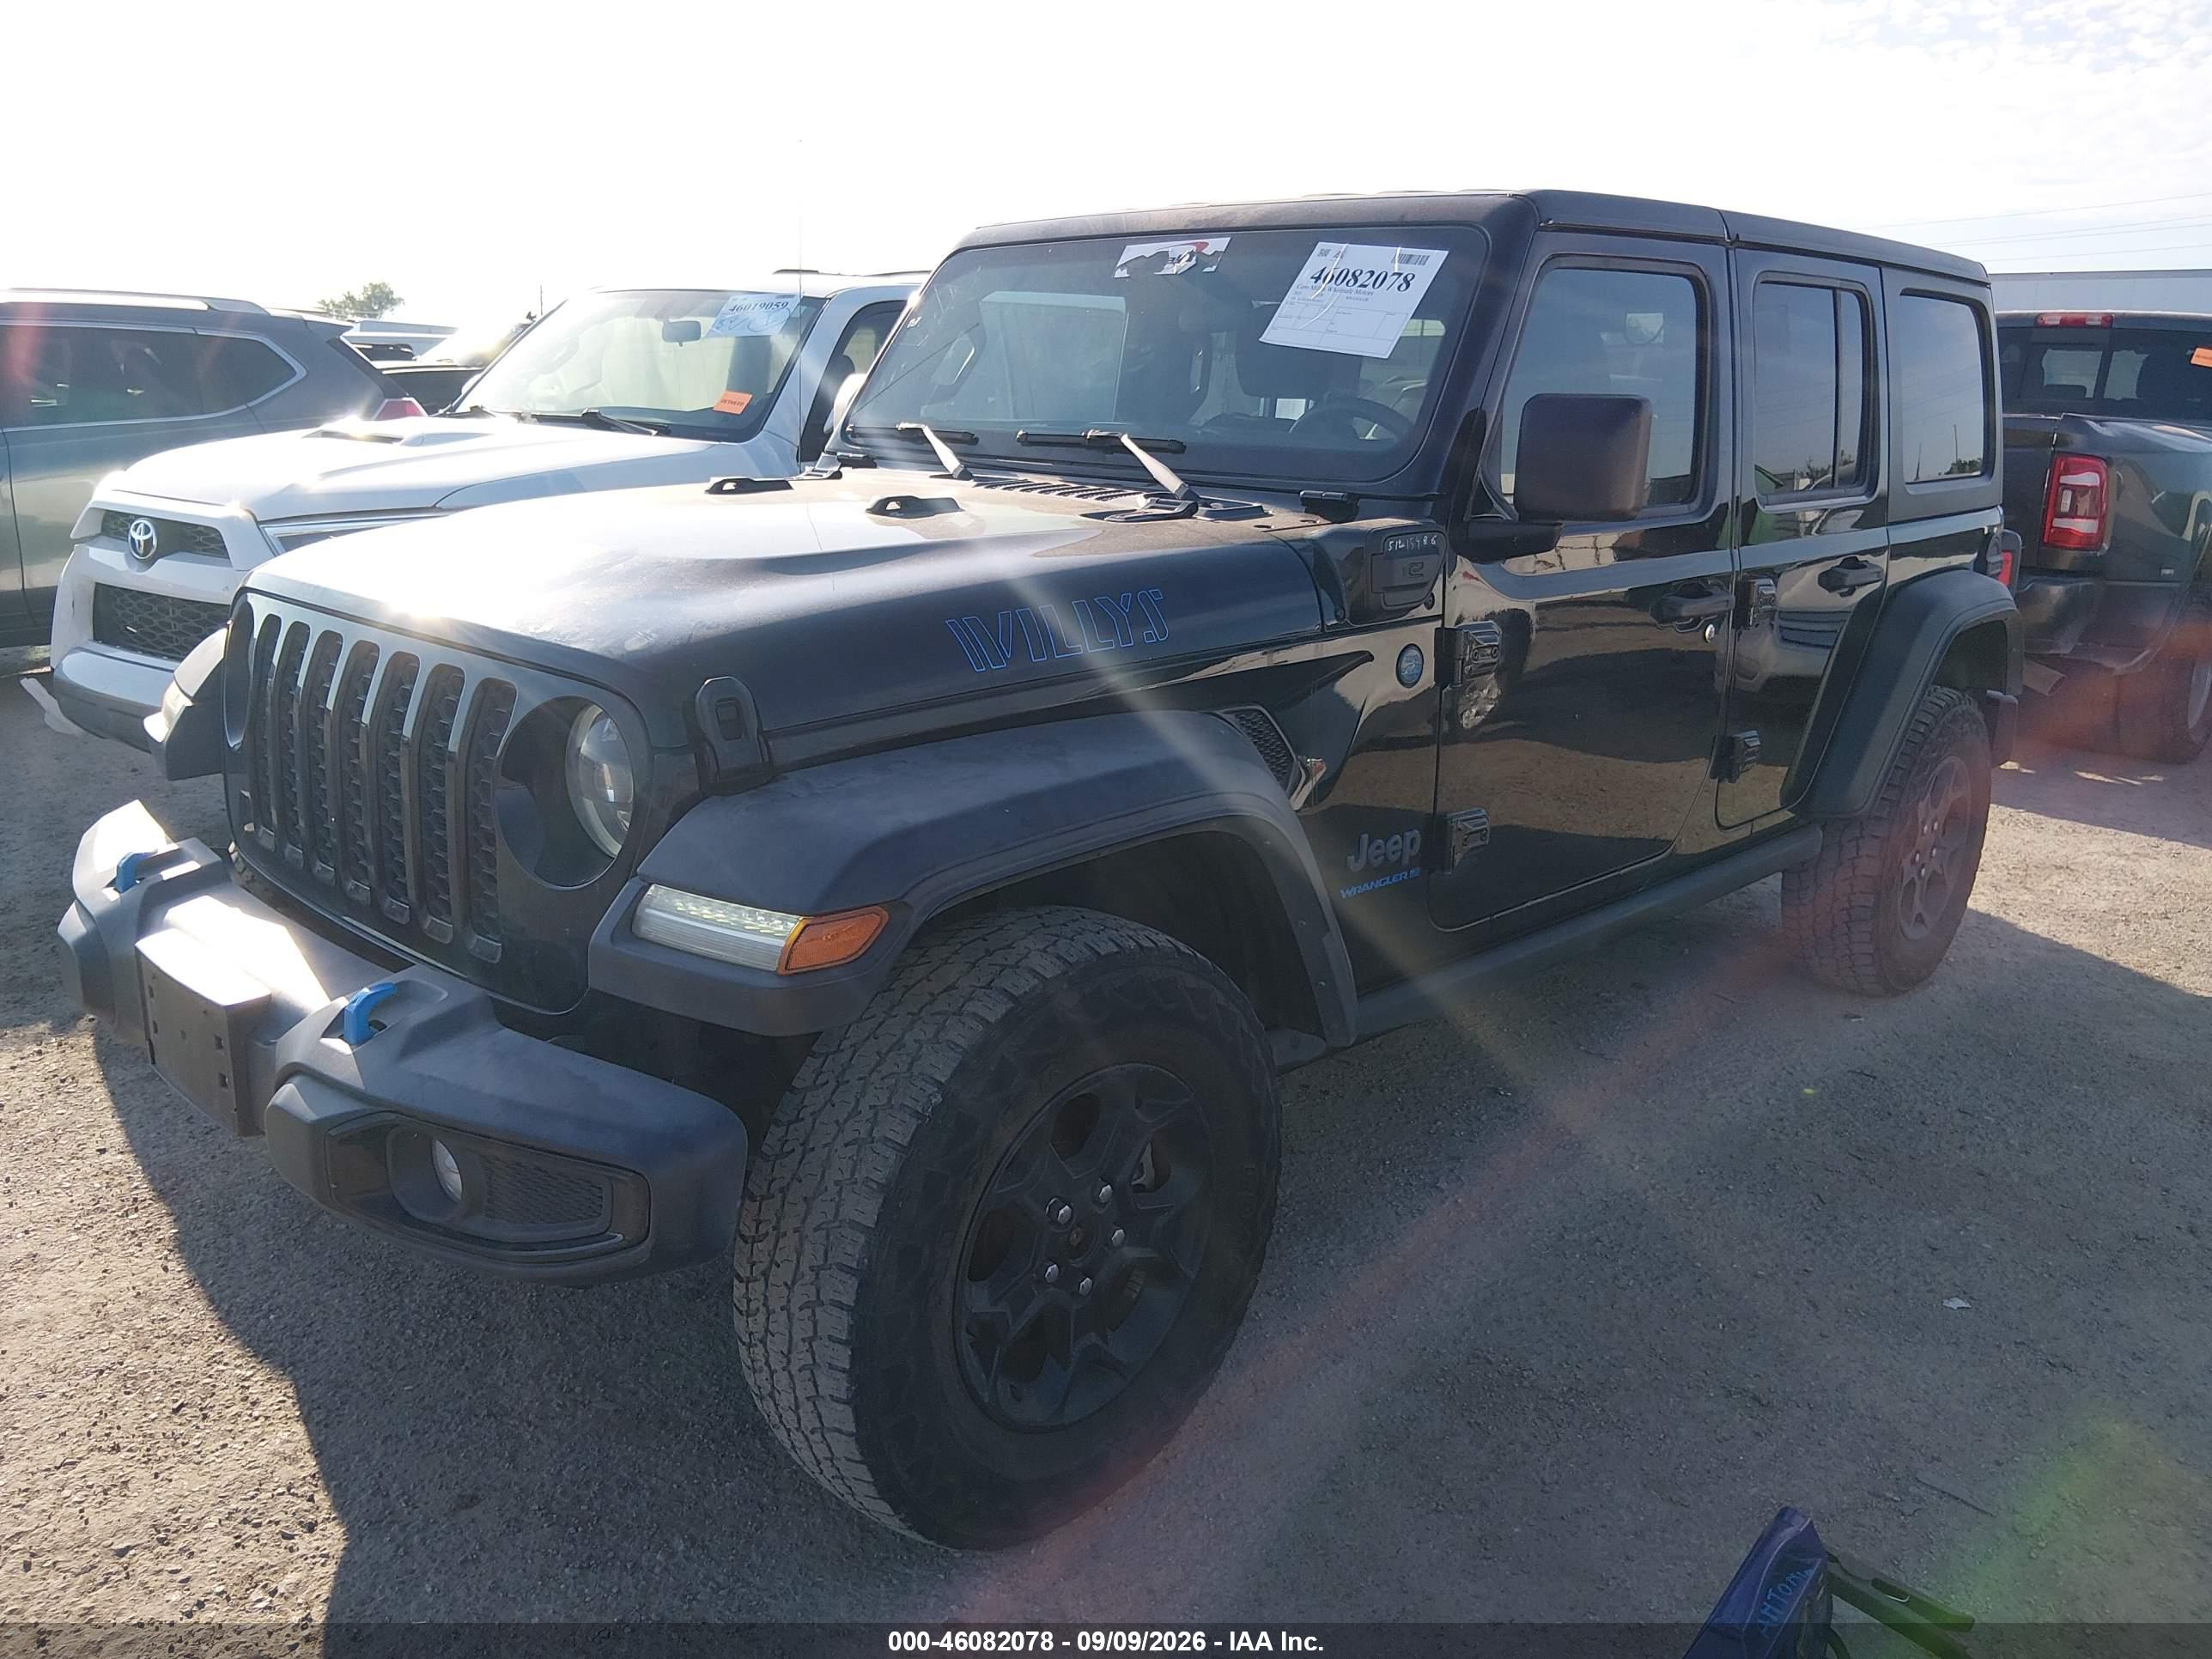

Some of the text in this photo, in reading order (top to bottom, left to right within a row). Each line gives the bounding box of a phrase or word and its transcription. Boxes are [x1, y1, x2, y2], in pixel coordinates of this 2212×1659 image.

[1310, 266, 1415, 292] 46082078
[945, 589, 1169, 672] WILLYS
[1346, 830, 1421, 872] Jeep
[1340, 871, 1408, 899] WRANGLER
